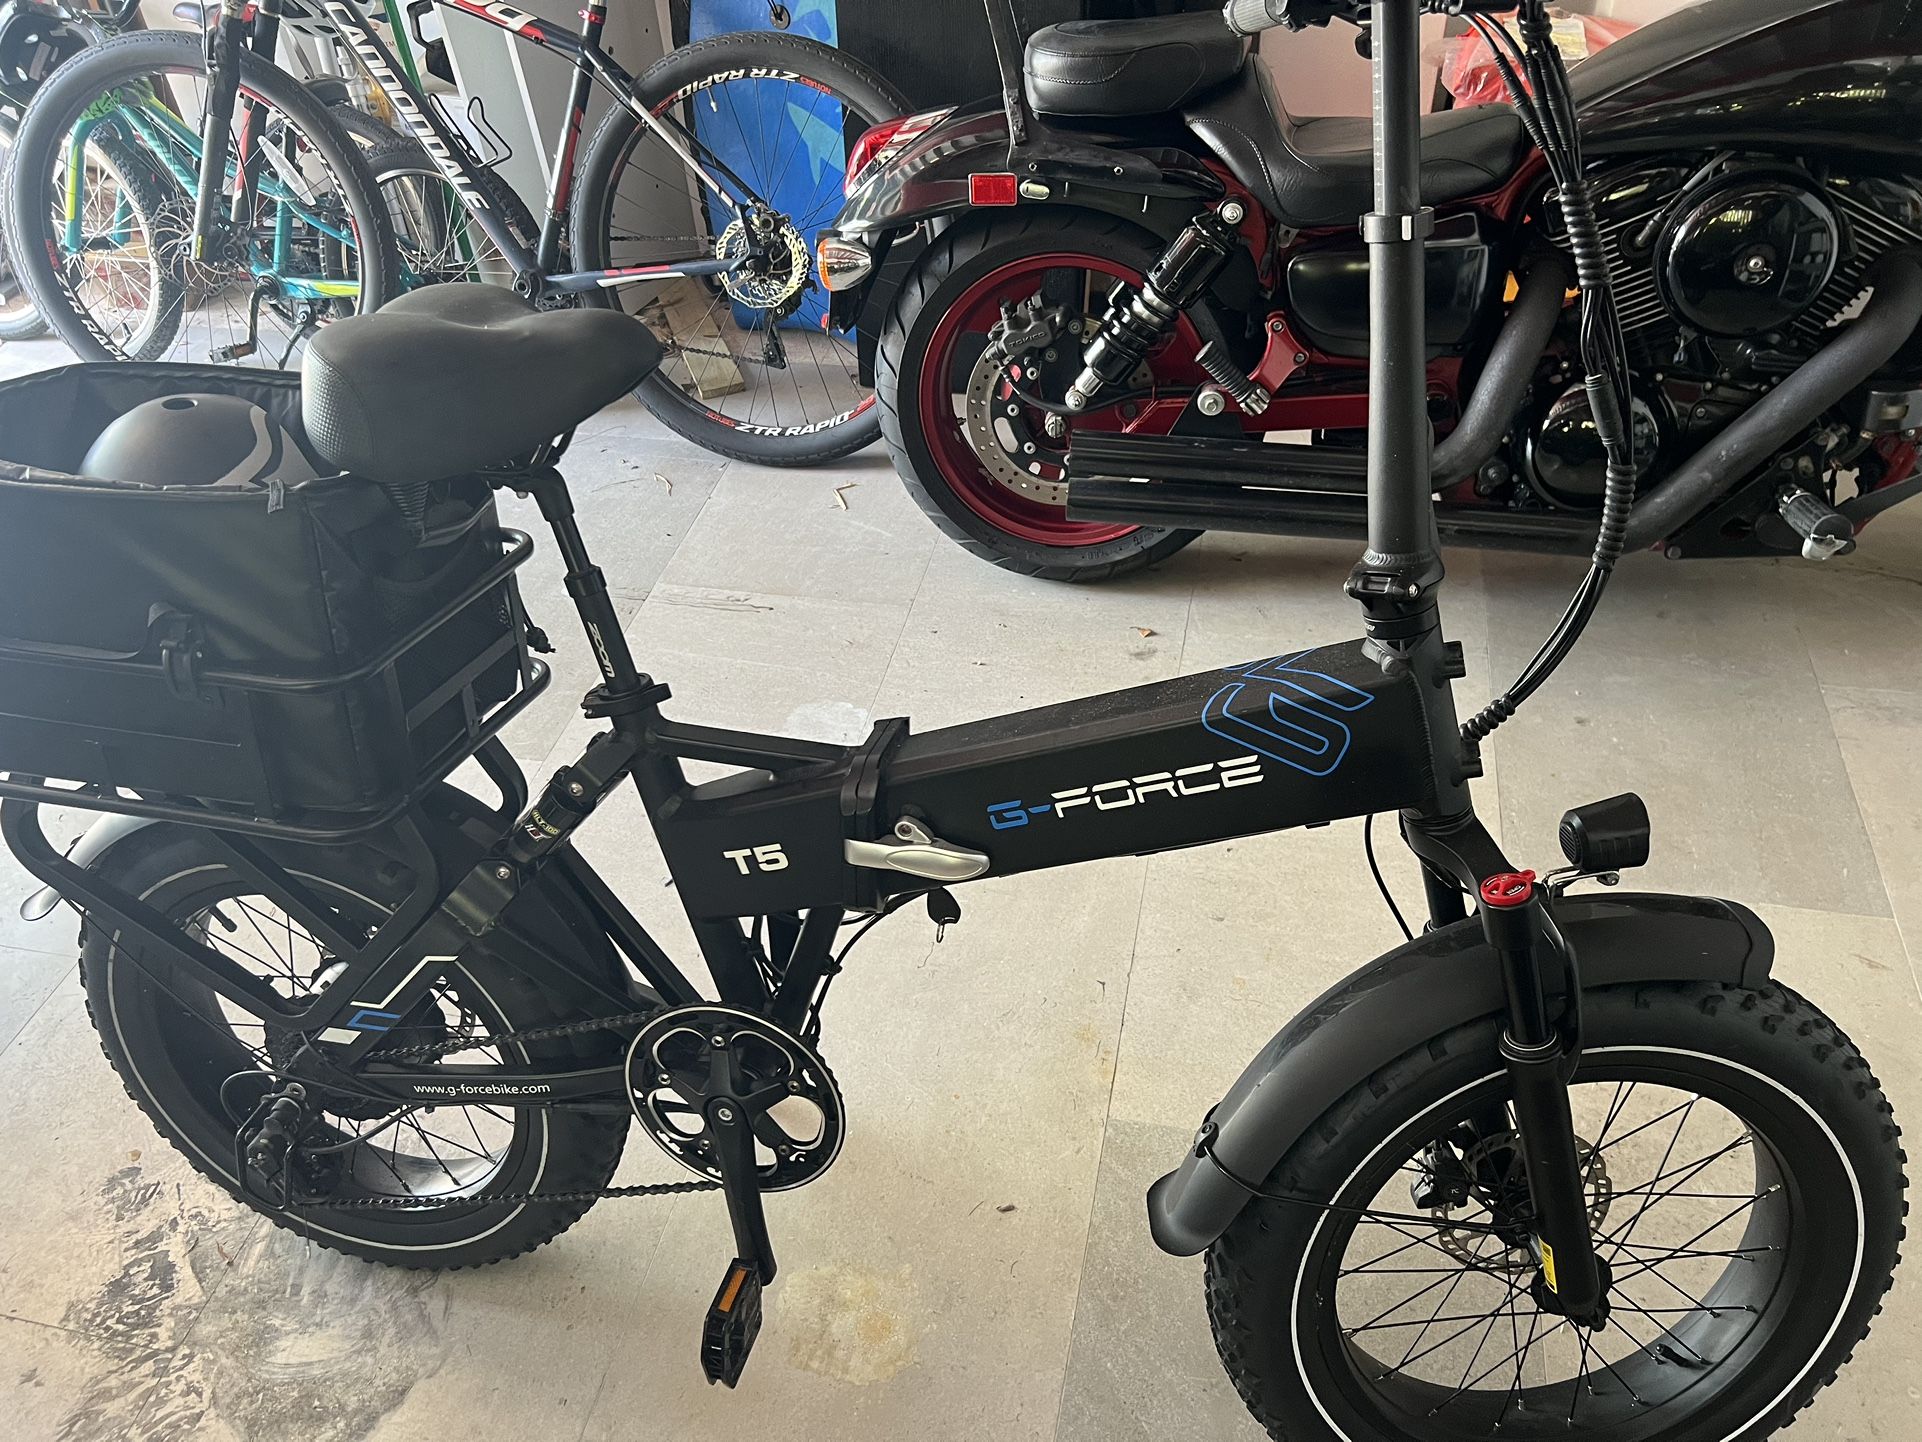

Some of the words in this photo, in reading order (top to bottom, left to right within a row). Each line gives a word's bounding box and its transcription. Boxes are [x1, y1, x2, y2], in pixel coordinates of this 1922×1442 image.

[677, 68, 746, 101] RAPID
[749, 68, 800, 82] ZTR
[324, 2, 491, 210] CANNONDALE
[53, 271, 86, 315] ZTR
[81, 319, 132, 361] RAPI
[735, 422, 784, 437] ZTR
[784, 411, 850, 437] RAPID
[986, 754, 1265, 830] G-FORCE
[723, 843, 789, 875] T5
[413, 1083, 551, 1096] www.g-forcebike.com
